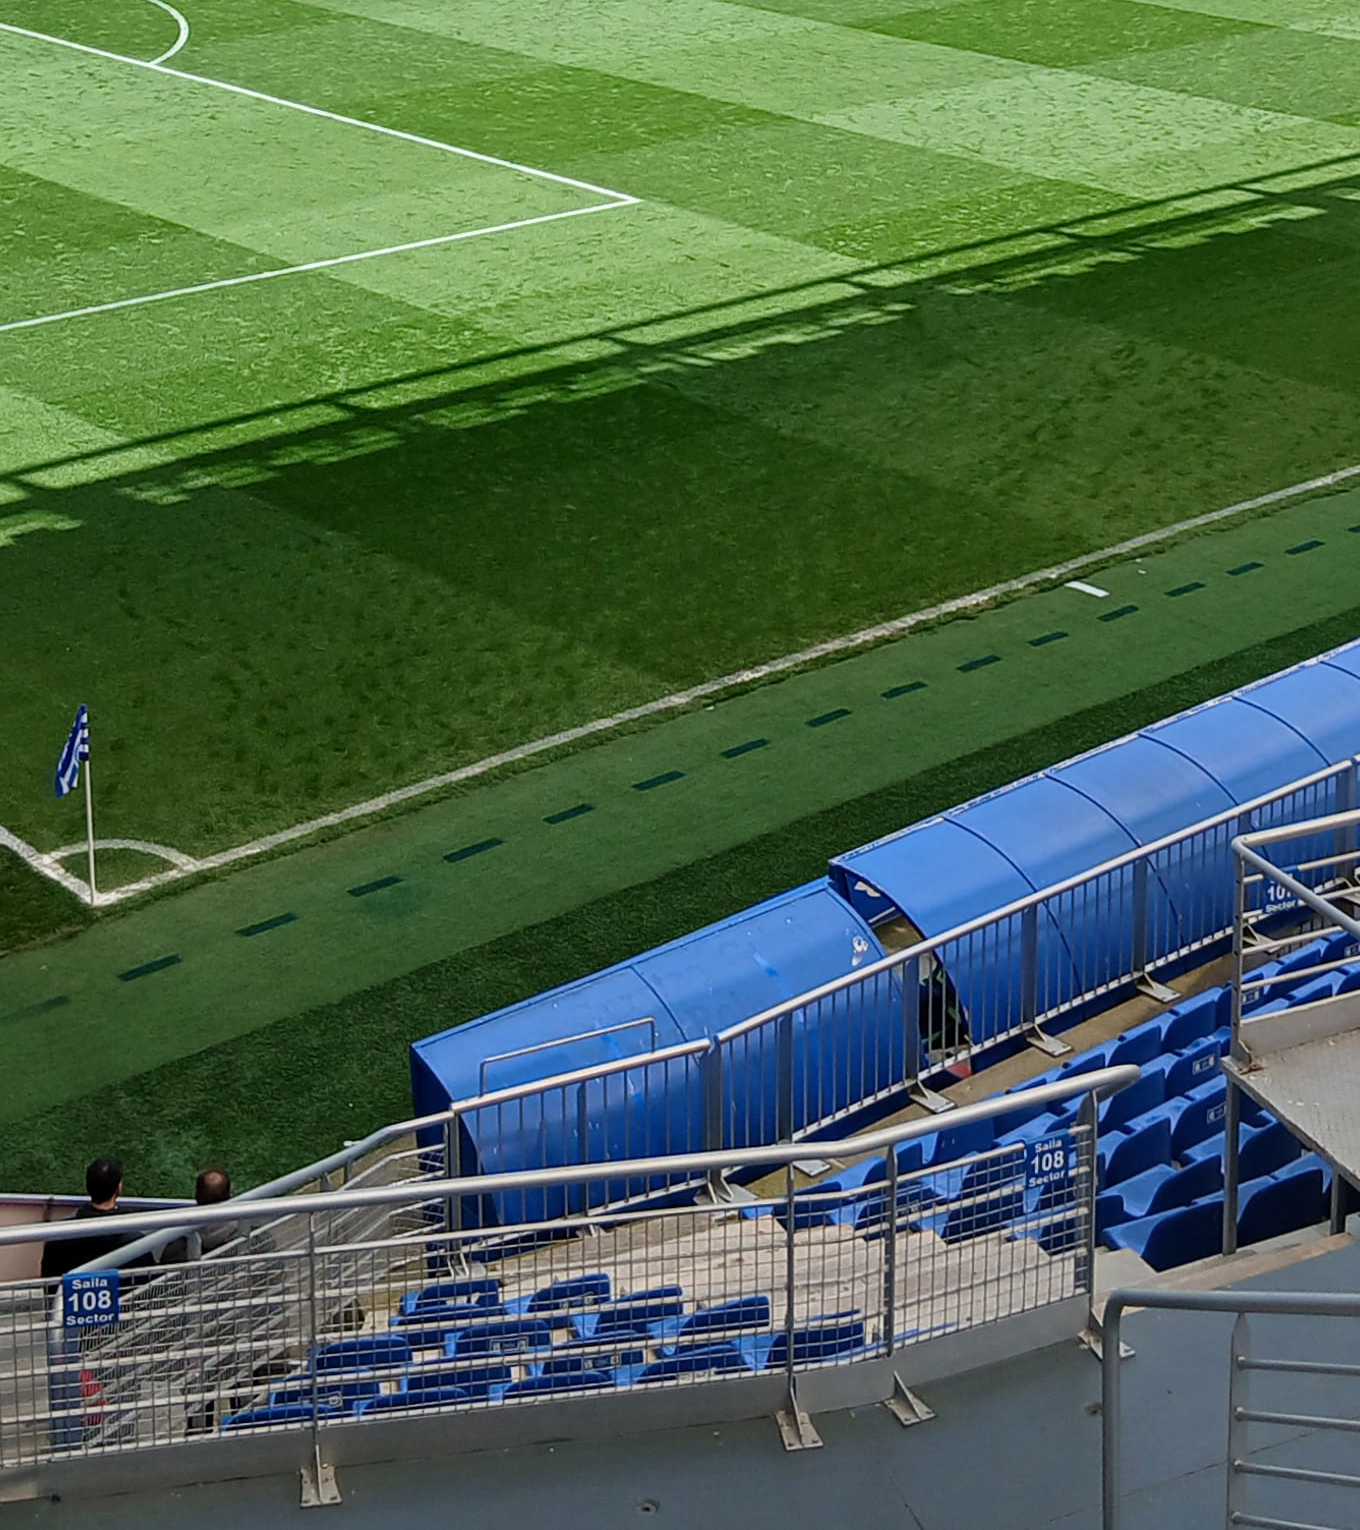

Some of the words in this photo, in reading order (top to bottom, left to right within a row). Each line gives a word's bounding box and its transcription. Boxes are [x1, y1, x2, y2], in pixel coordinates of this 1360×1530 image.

[1034, 1136, 1062, 1153] Saila
[1031, 1150, 1064, 1174] 108
[1028, 1170, 1066, 1187] Sector
[72, 1277, 108, 1290] Saila
[68, 1290, 112, 1312] 108
[66, 1313, 115, 1326] Sector
